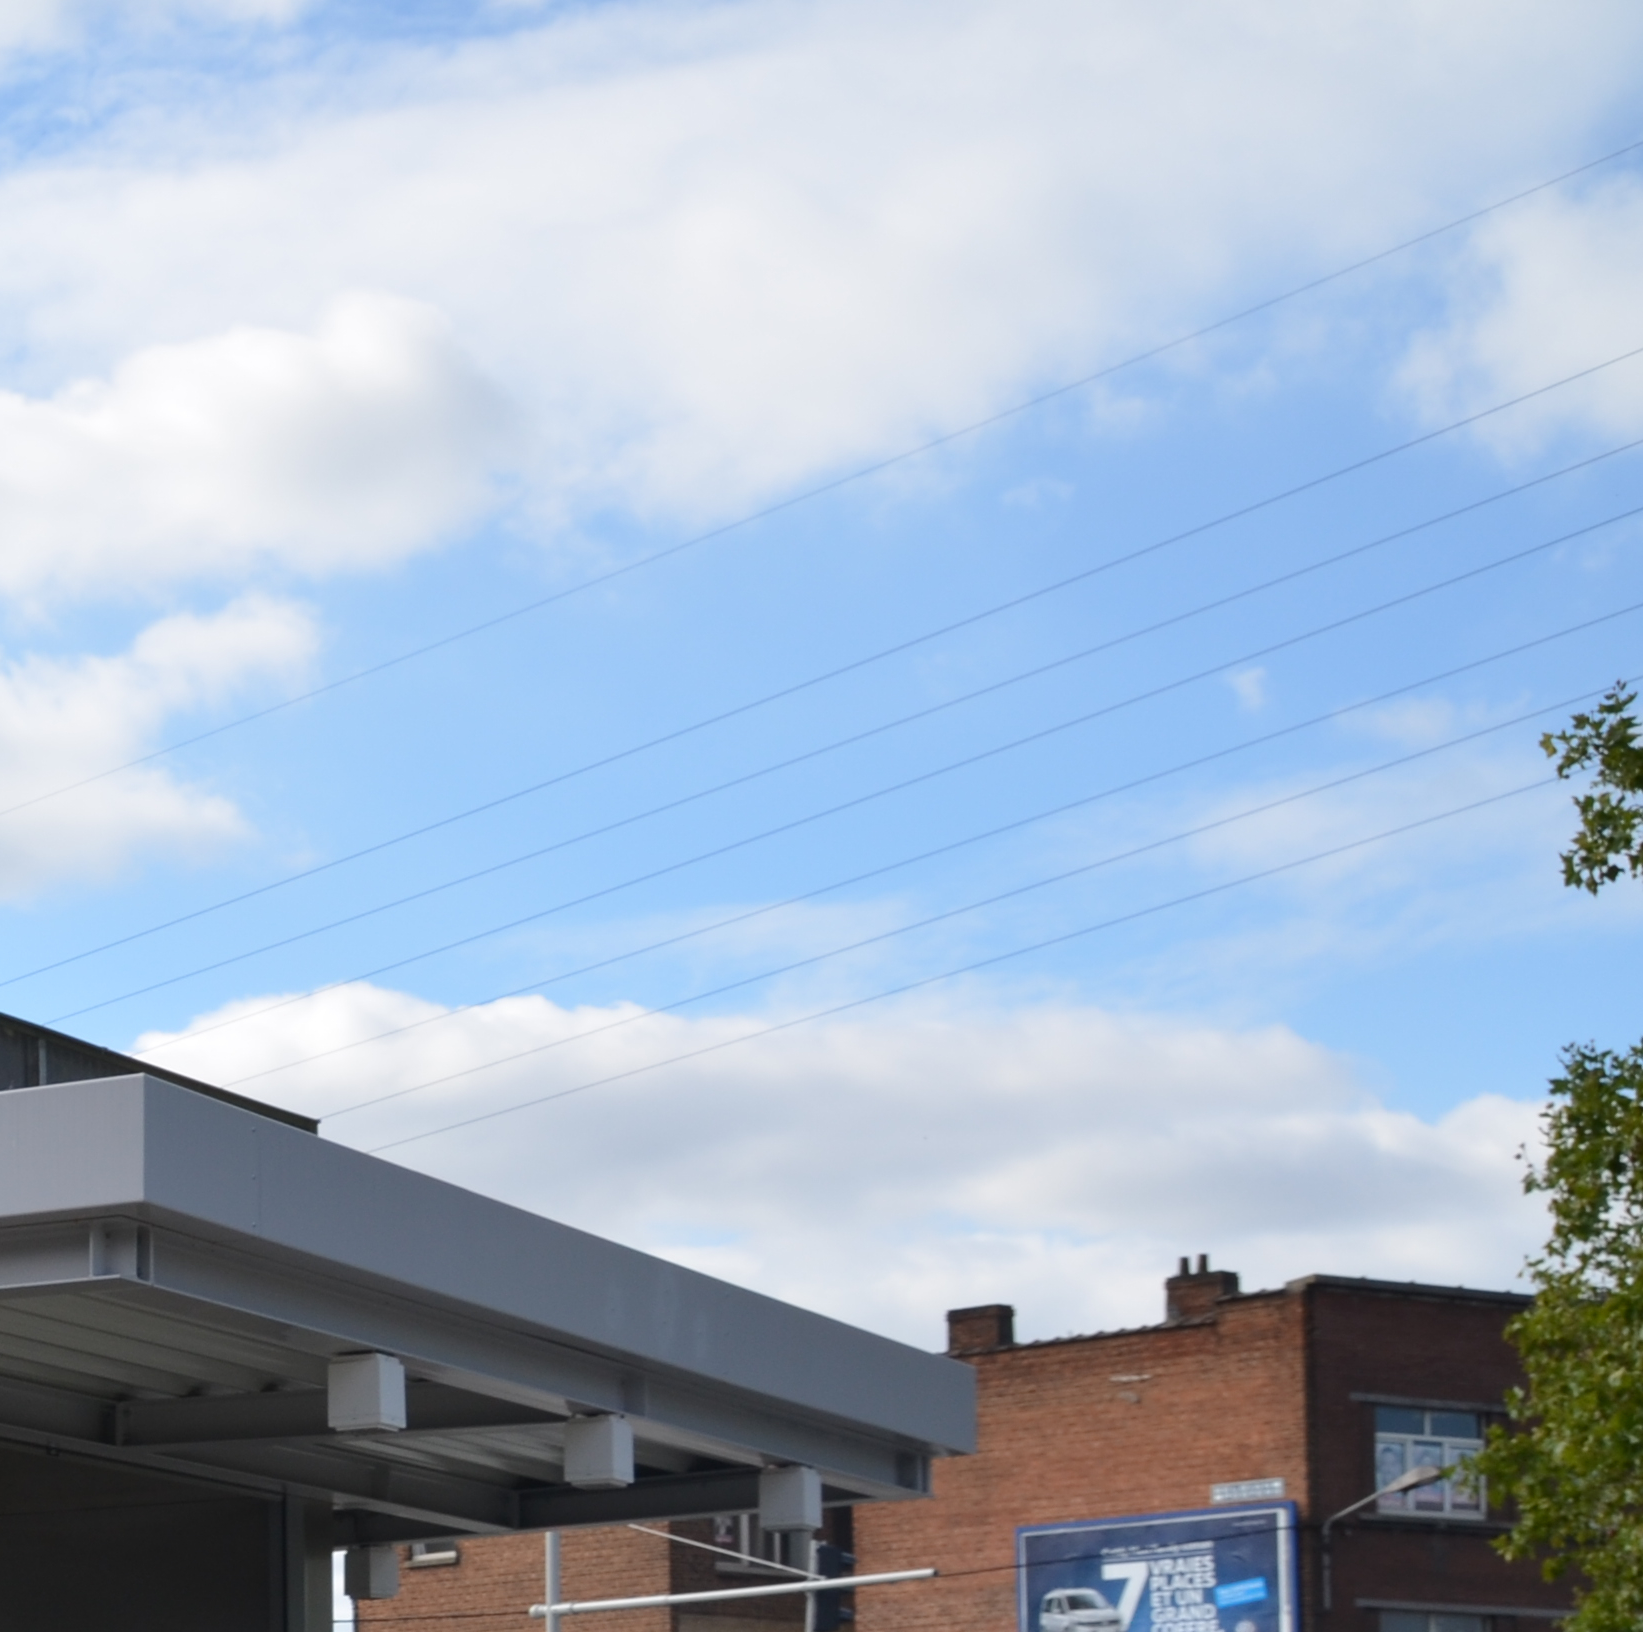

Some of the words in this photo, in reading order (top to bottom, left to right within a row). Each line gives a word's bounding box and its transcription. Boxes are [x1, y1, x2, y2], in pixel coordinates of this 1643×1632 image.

[1148, 1555, 1215, 1575] VRAIES
[1149, 1571, 1216, 1591] PLACES
[1101, 1561, 1149, 1632] 7
[1150, 1591, 1171, 1608] ET
[1175, 1588, 1203, 1606] UN
[1150, 1604, 1216, 1623] GRAND
